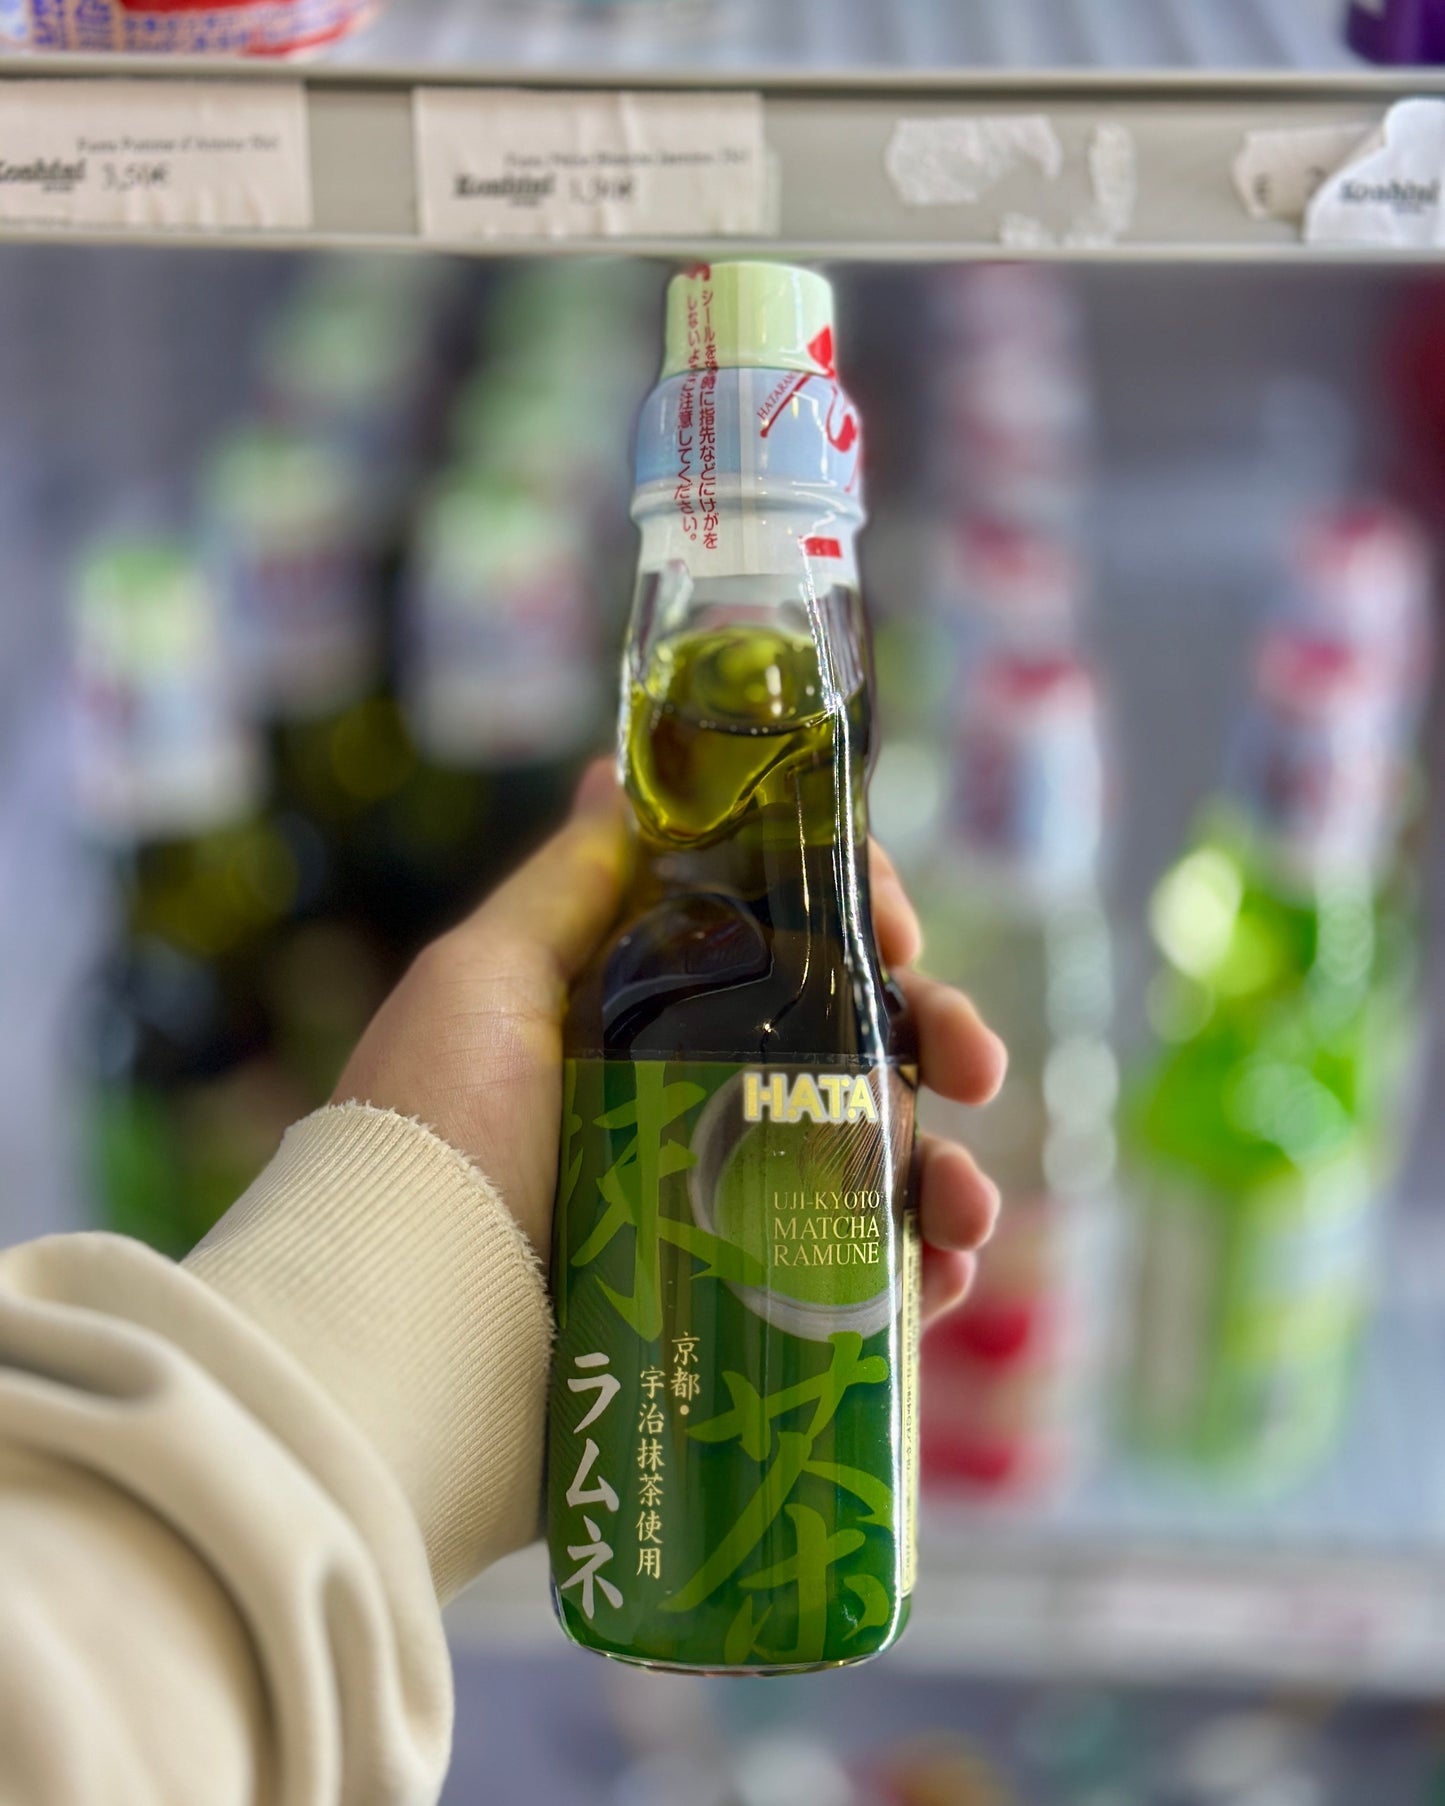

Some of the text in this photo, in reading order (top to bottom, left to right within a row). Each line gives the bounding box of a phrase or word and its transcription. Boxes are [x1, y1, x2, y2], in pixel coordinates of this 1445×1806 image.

[744, 1073, 879, 1123] HATA
[773, 1191, 880, 1210] UJI-KYOTO
[773, 1215, 880, 1240] MATCHA
[773, 1241, 880, 1267] RAMUNE
[560, 1352, 624, 1620] ラムネ
[635, 1365, 666, 1580] 宇治抹茶使用
